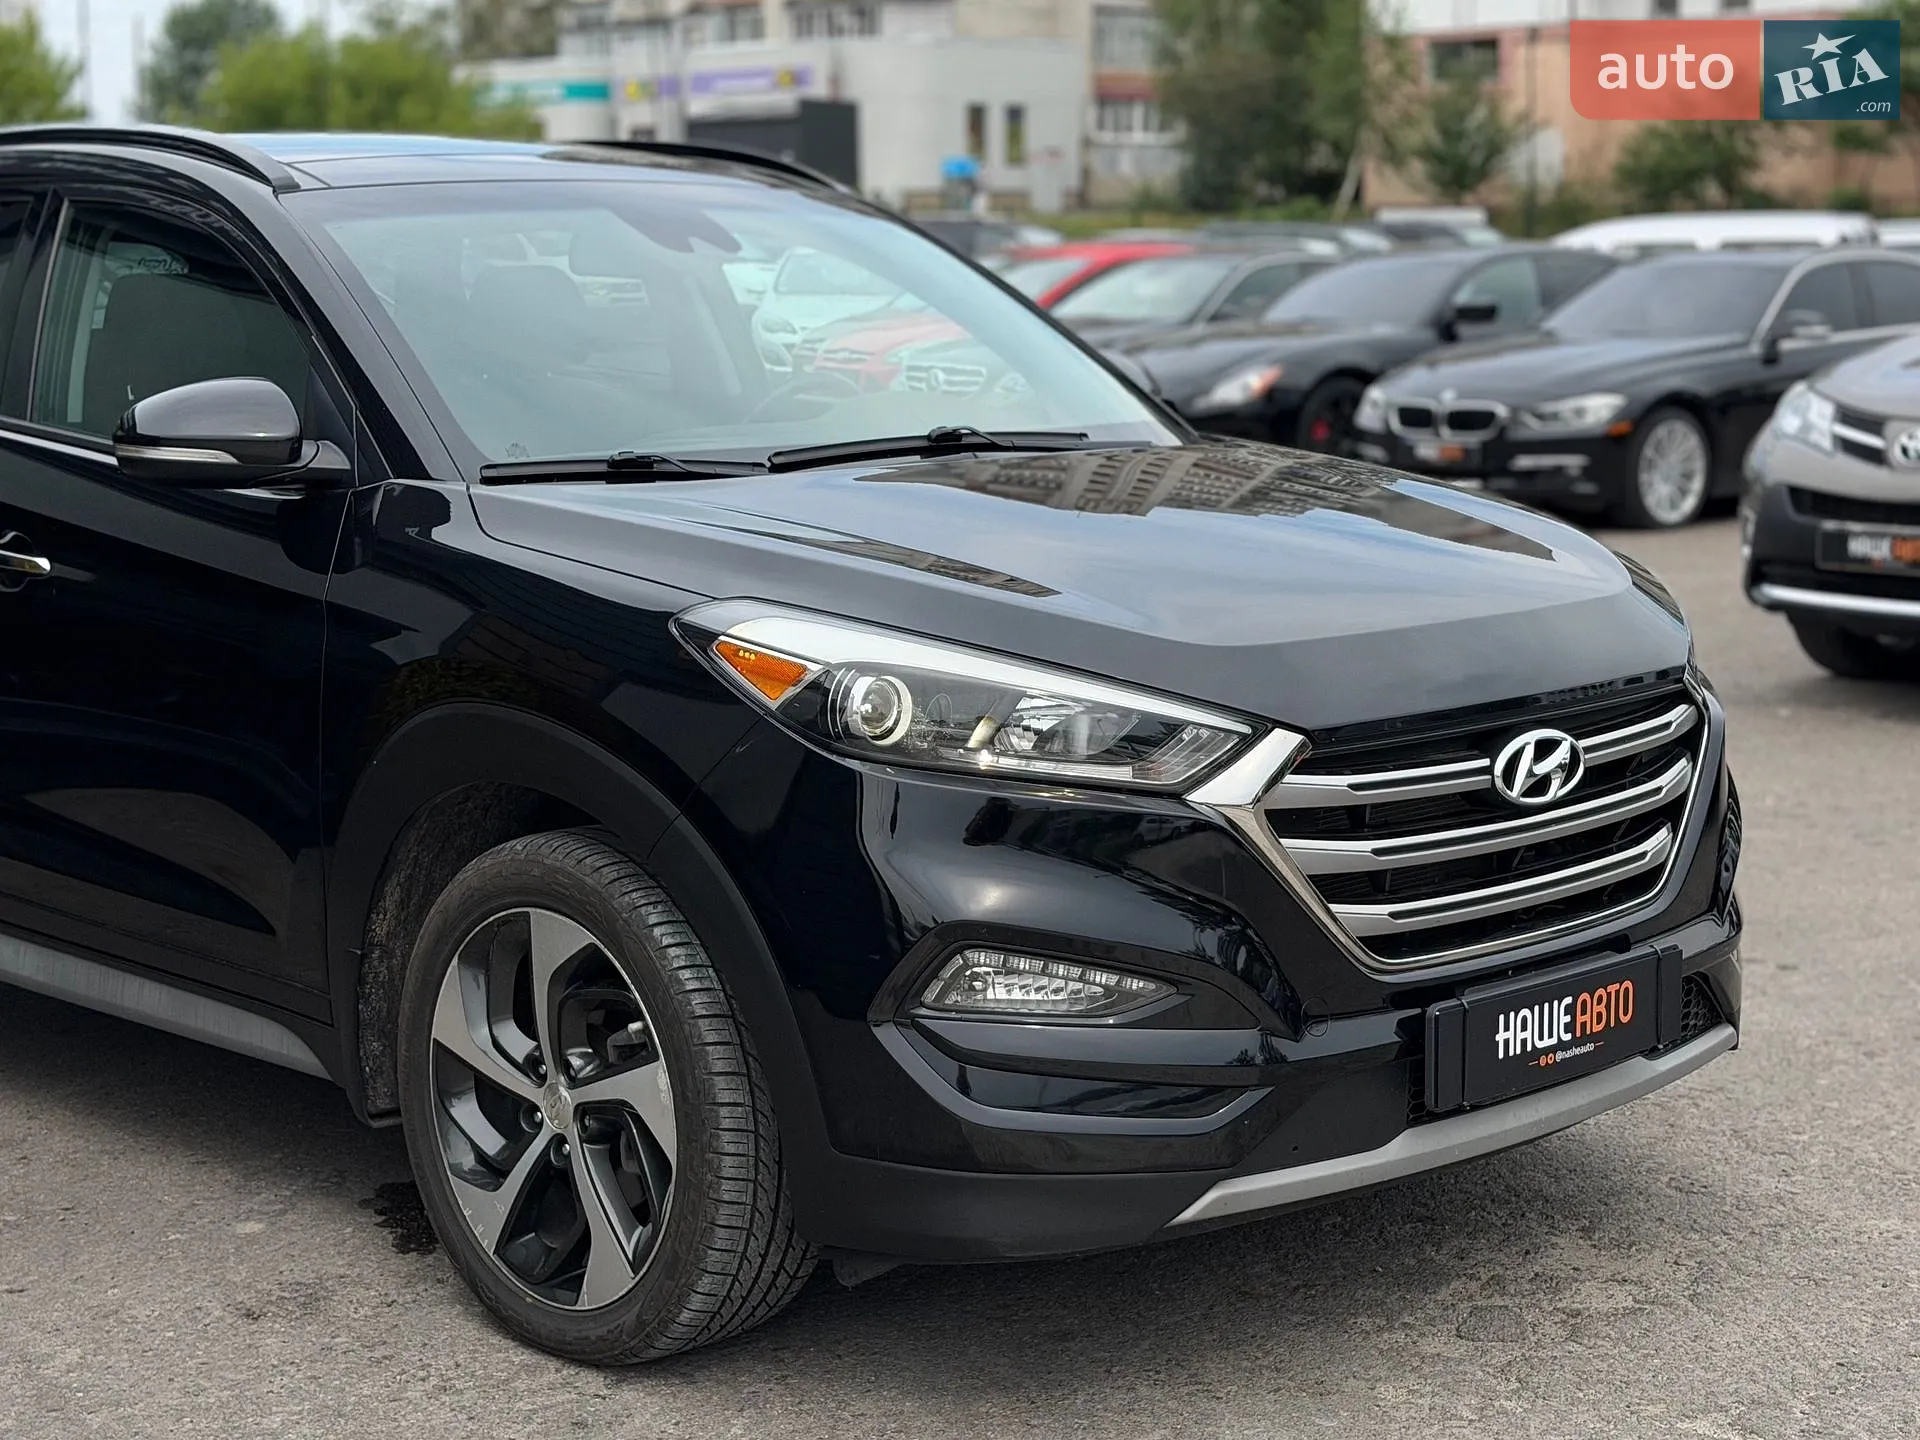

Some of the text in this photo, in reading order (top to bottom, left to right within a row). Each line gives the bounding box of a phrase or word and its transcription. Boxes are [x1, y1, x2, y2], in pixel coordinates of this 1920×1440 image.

[1496, 980, 1633, 1059] НАШЕ АВТО
[1555, 1042, 1595, 1063] @nasheauto
